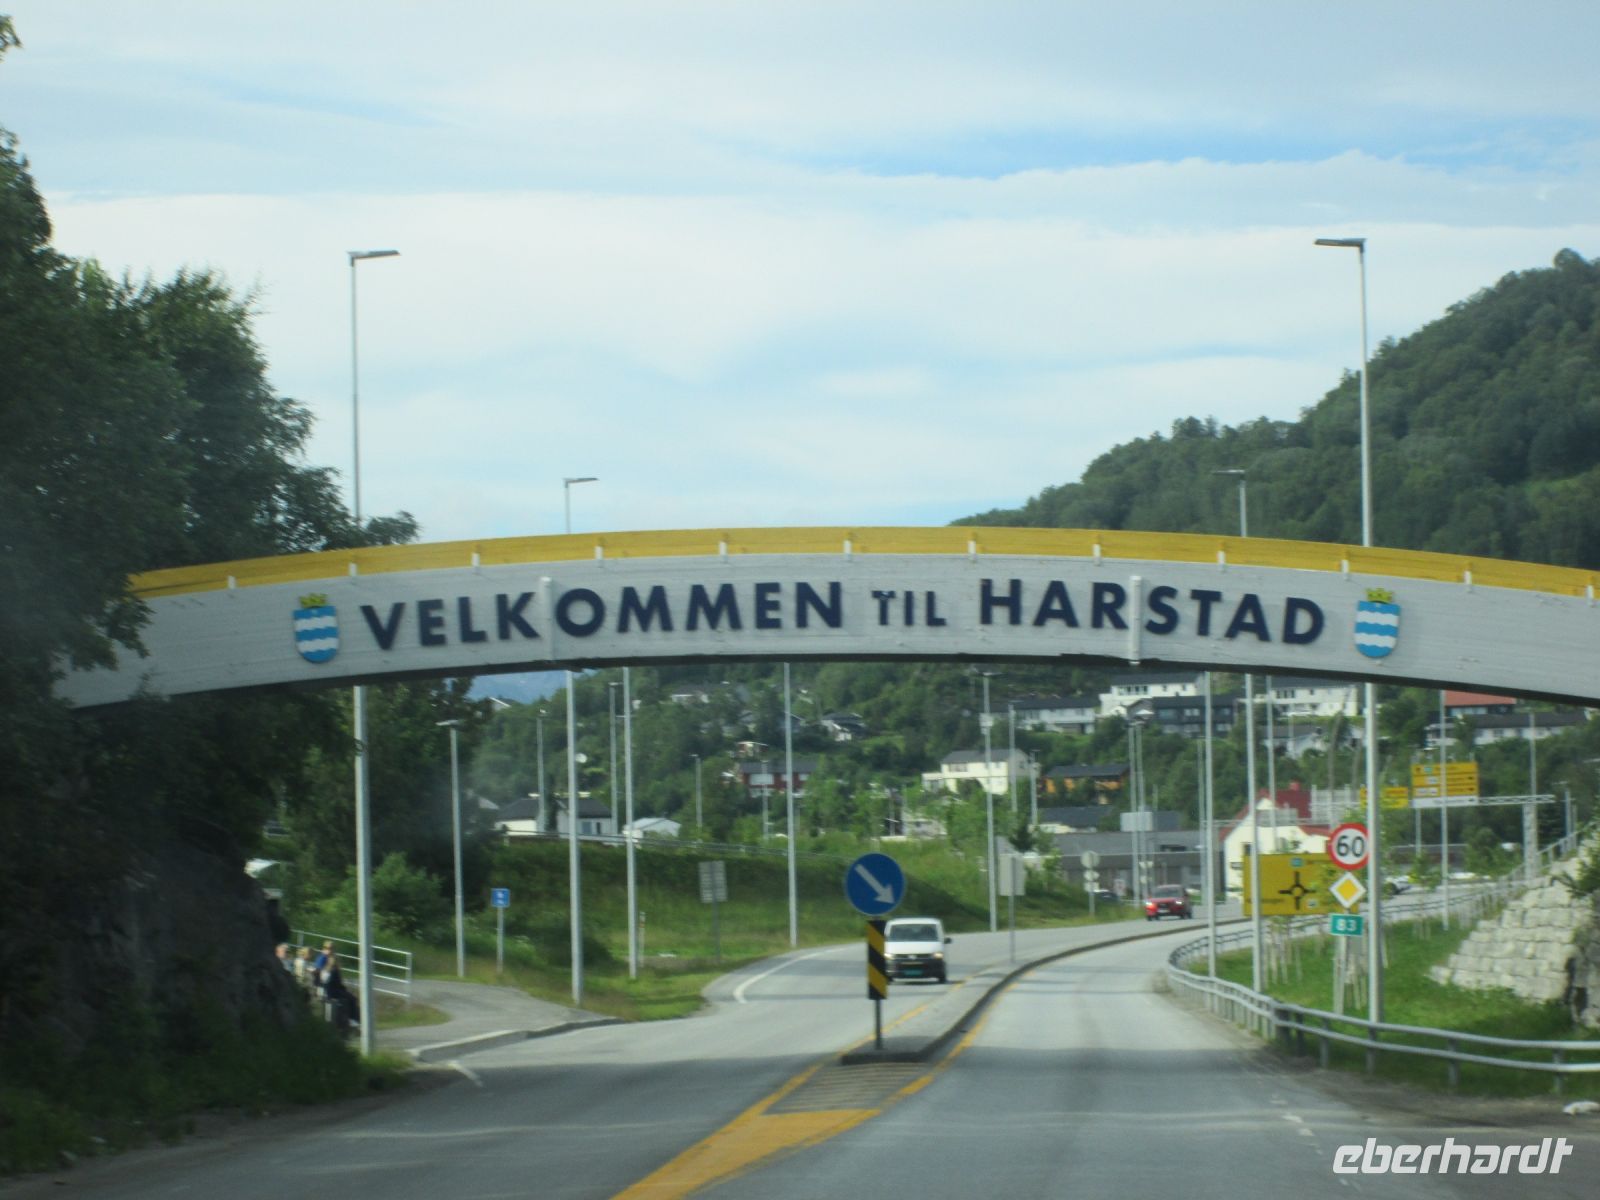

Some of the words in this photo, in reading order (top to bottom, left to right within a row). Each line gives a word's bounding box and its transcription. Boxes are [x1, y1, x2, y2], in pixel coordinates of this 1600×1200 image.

[360, 581, 843, 651] VELKOMMEN
[871, 590, 947, 627] TIL
[979, 578, 1326, 645] HARSTAD
[1337, 835, 1365, 857] 60
[1336, 918, 1357, 932] 83
